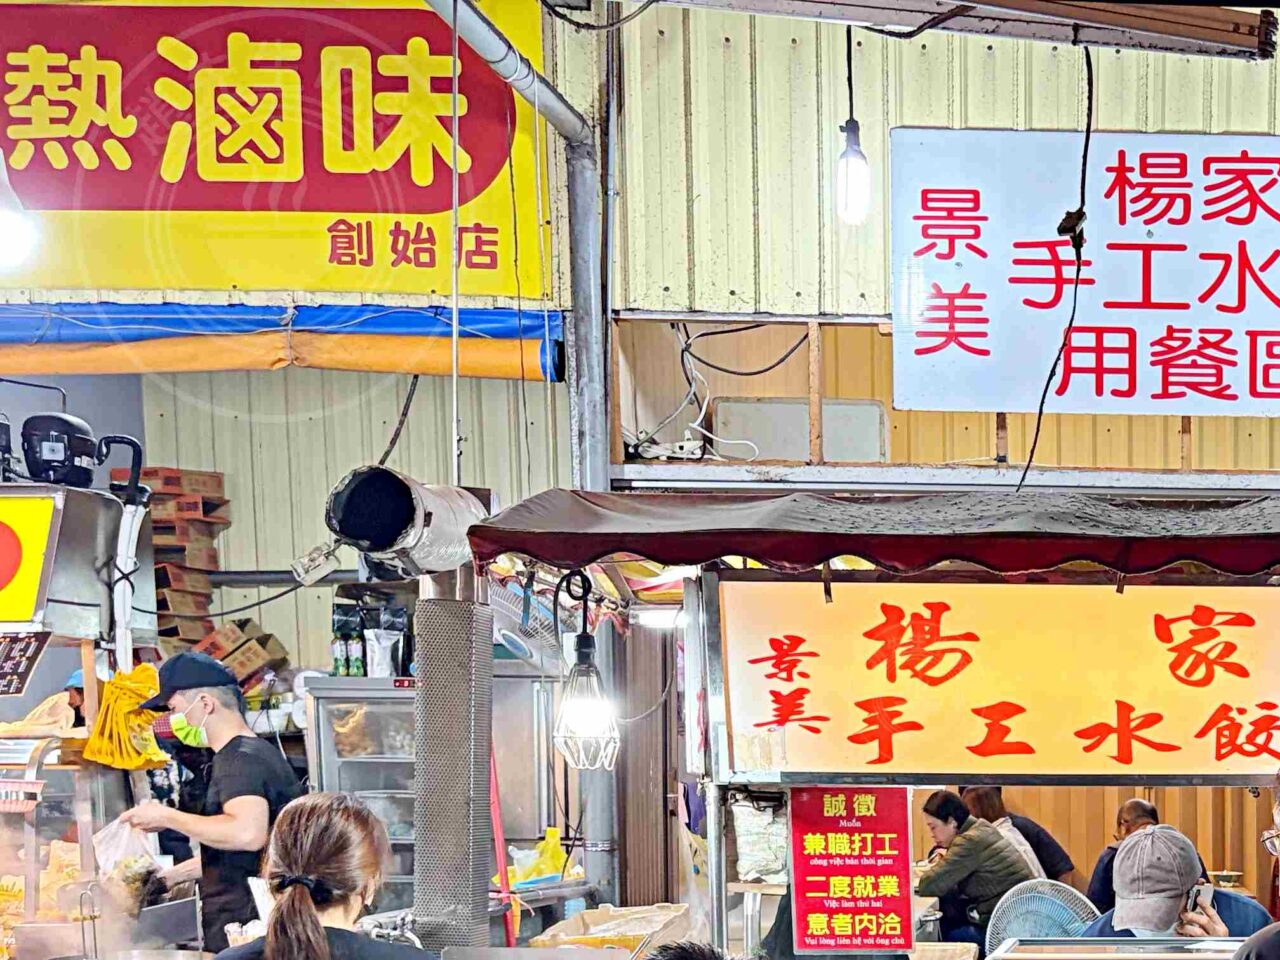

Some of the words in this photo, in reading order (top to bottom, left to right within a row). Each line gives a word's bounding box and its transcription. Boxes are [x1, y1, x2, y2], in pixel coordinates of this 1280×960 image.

[4, 32, 472, 187] 熱滷味
[327, 218, 499, 270] 創始店
[912, 188, 991, 357] 景美
[863, 601, 1256, 688] 楊家
[747, 634, 831, 735] 景美
[823, 794, 877, 817] 誠徵
[803, 832, 899, 856] 兼職打工
[805, 875, 900, 898] 二度就業
